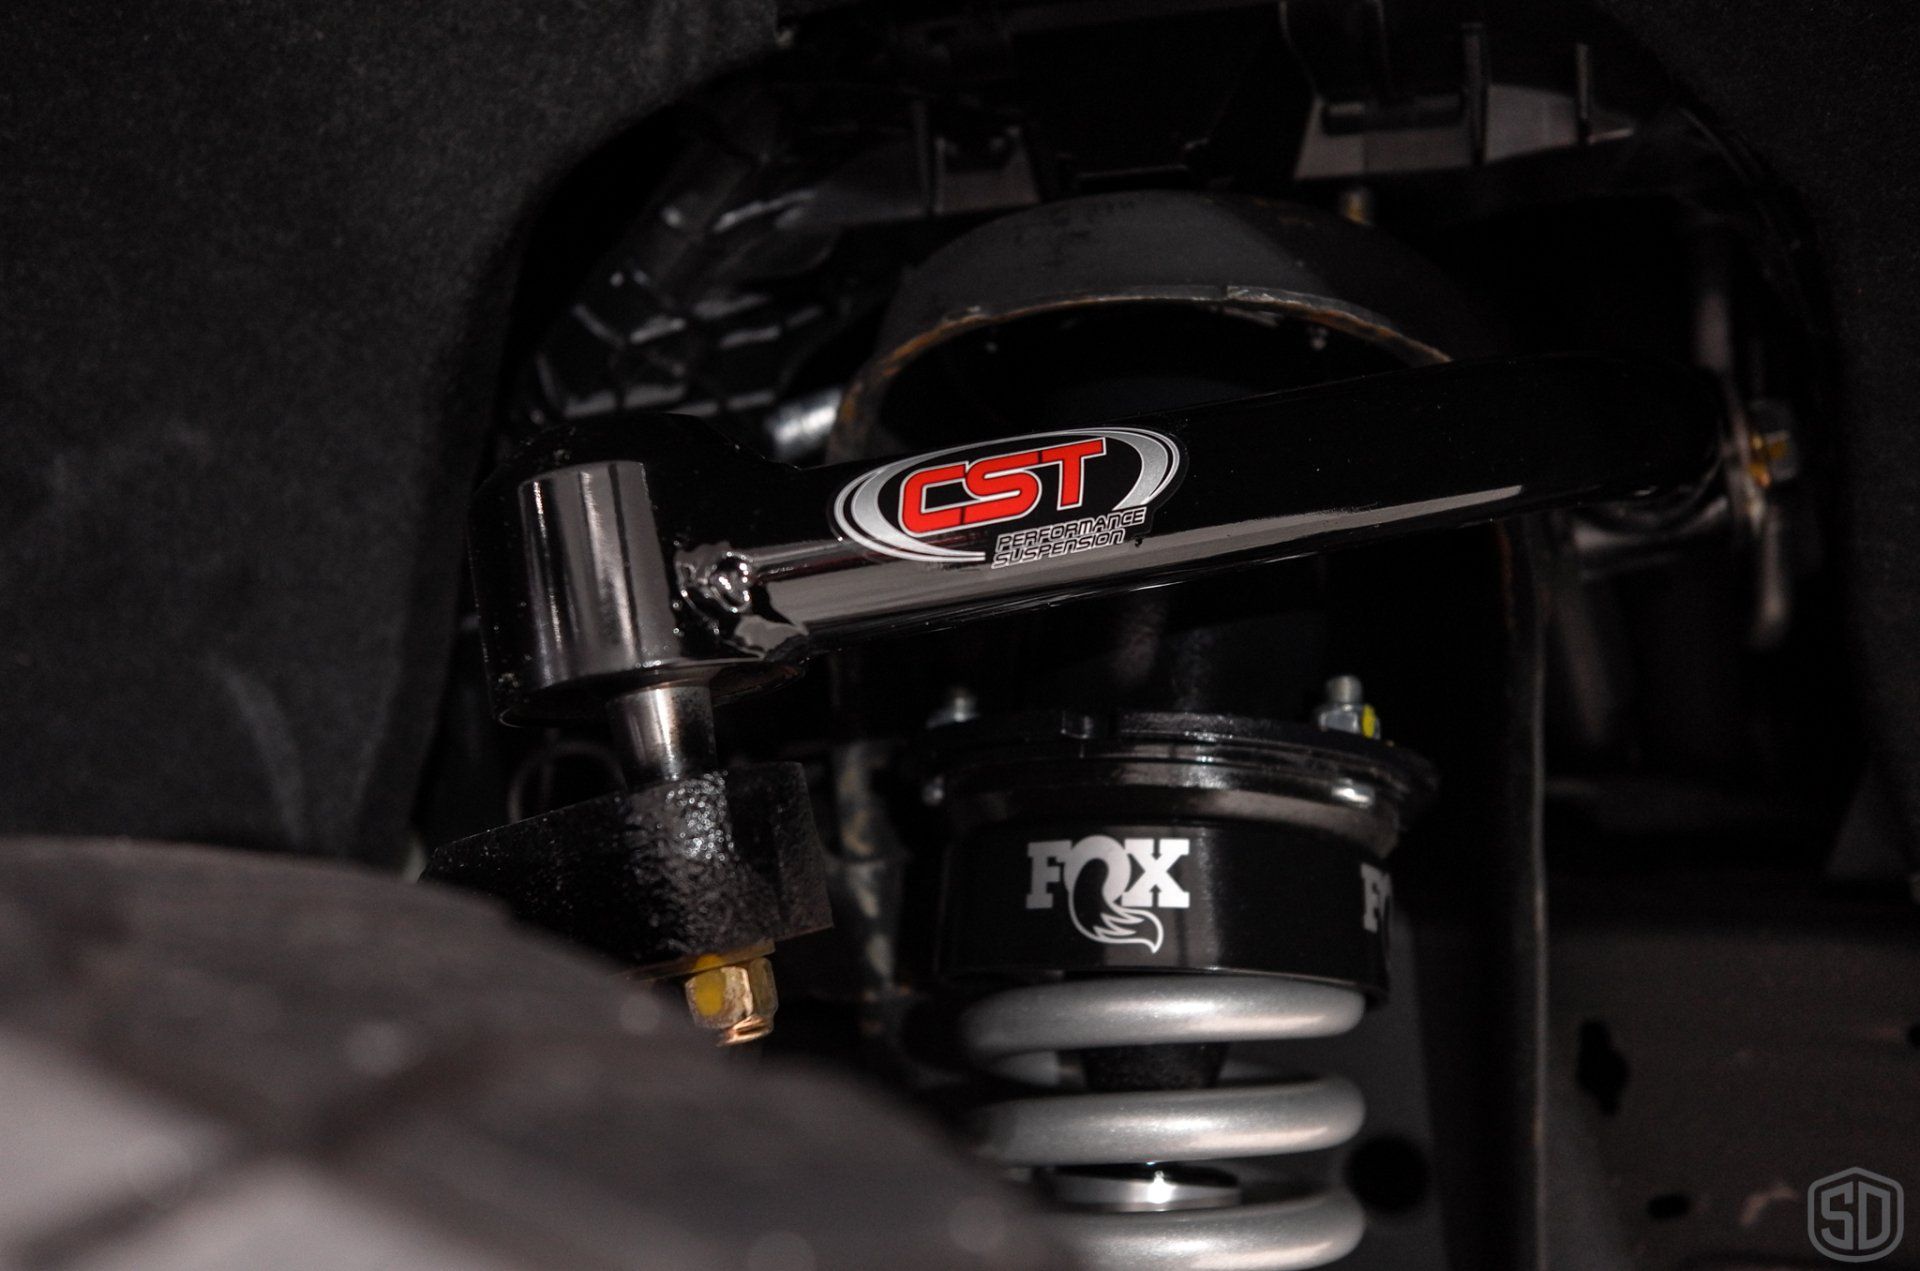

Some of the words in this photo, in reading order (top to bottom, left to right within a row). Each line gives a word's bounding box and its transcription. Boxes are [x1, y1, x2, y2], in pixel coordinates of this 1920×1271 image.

[899, 437, 1106, 538] CST
[991, 528, 1125, 569] SUSPENSION
[996, 507, 1147, 552] PERFORMANCE
[1026, 834, 1190, 950] FOX
